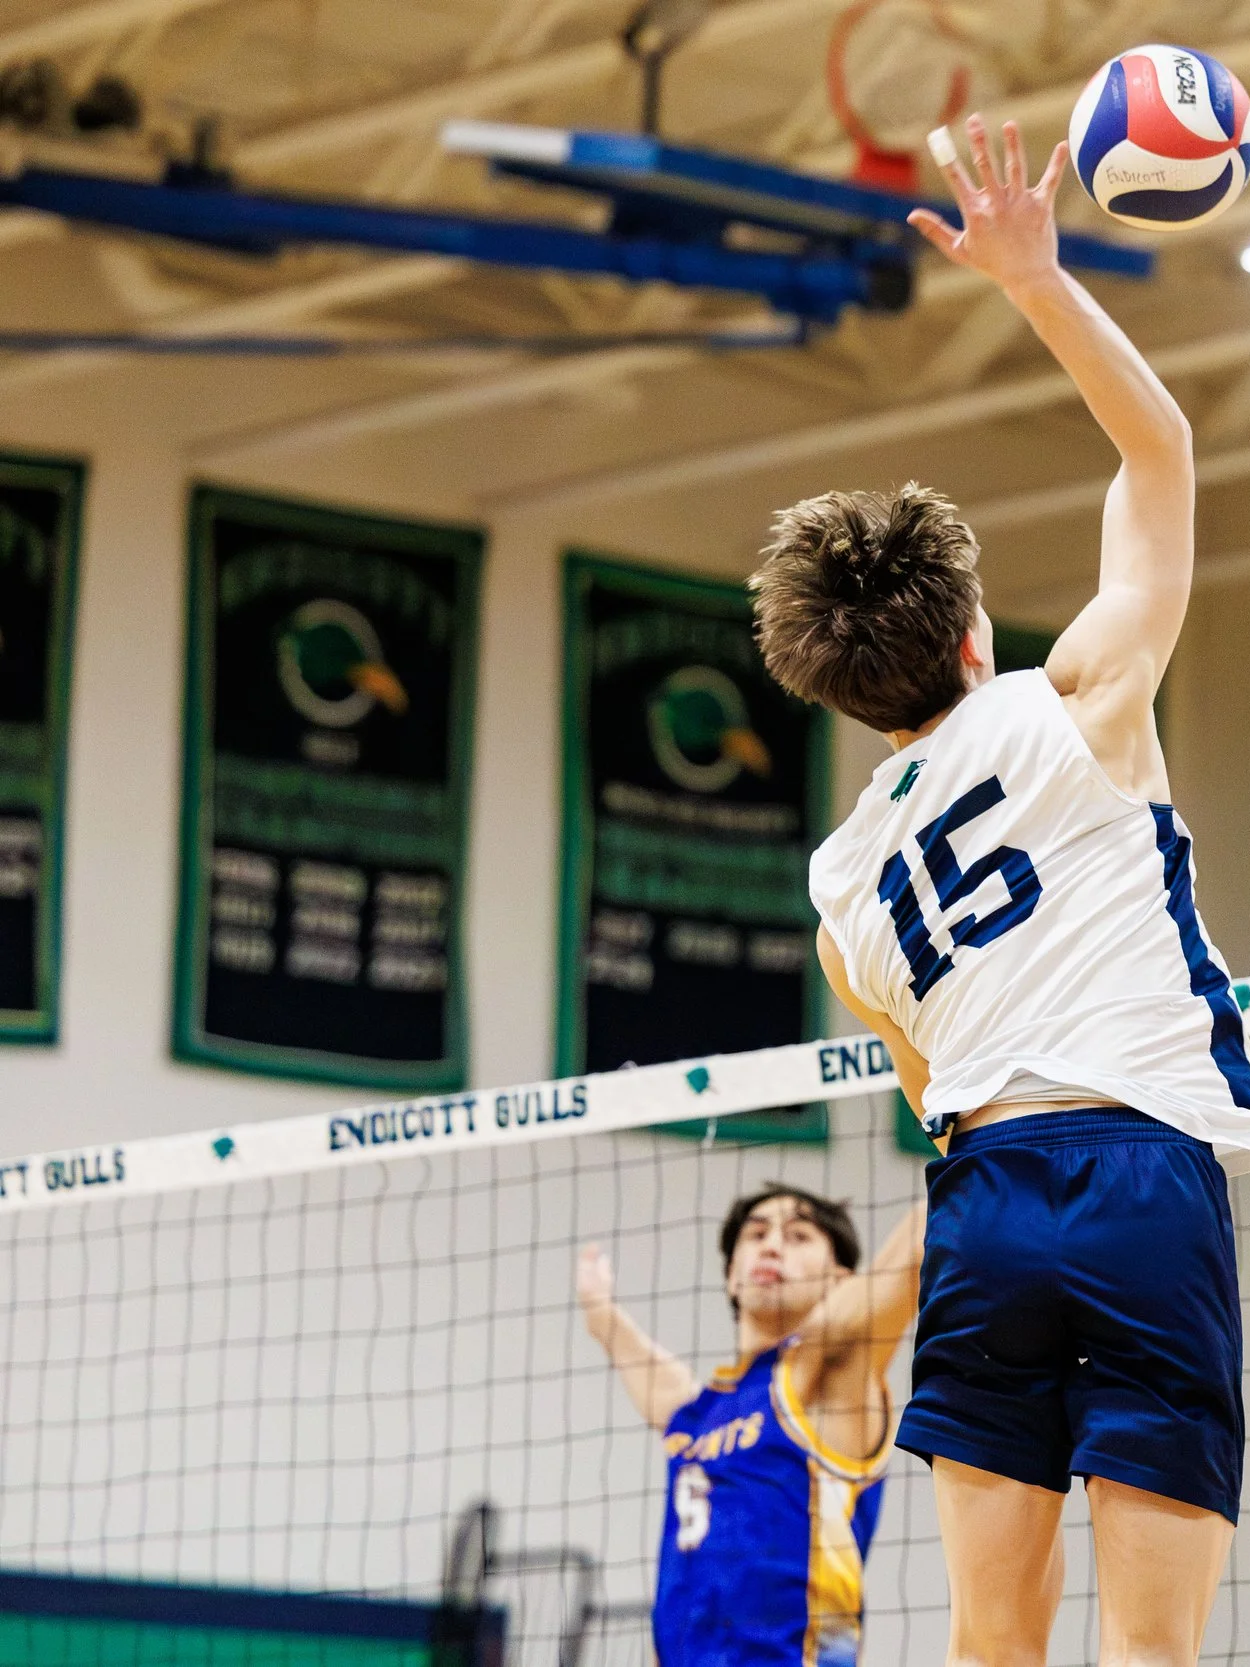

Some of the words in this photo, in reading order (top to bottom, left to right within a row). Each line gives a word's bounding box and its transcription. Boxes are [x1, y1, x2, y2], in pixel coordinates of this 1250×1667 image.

[877, 774, 1044, 1003] 15
[329, 1098, 478, 1151] ENDICOTT
[495, 1084, 588, 1129] GULLS
[44, 1149, 125, 1191] GULLS
